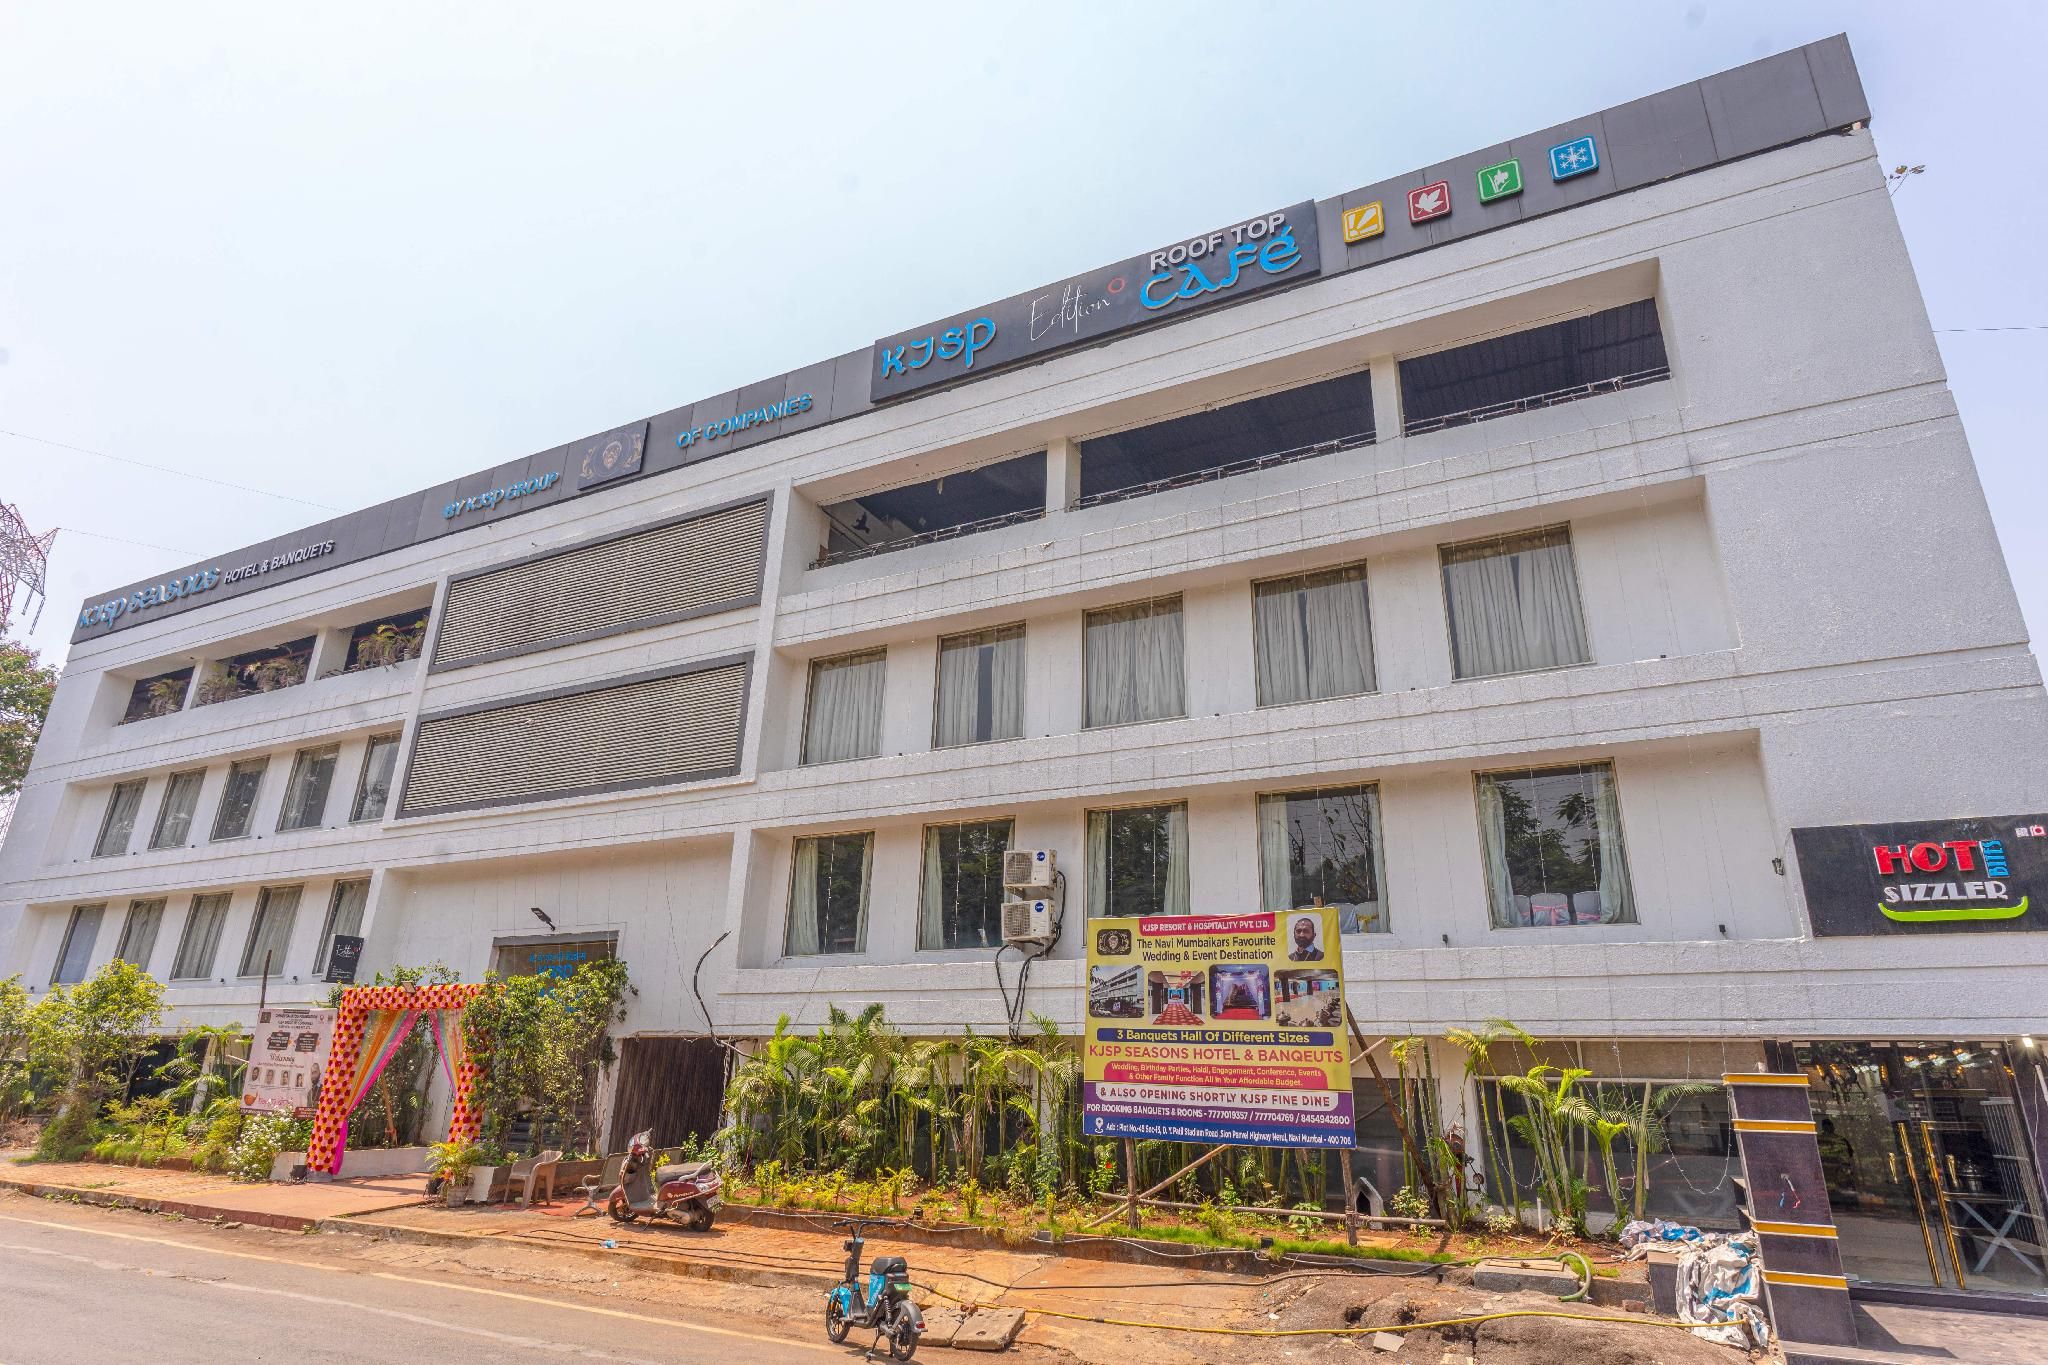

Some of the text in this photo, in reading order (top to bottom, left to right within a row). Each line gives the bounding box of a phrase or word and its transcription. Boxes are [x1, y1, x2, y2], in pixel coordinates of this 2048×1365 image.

[1150, 213, 1285, 273] ROOF TOP
[505, 471, 560, 500] GROUP
[675, 427, 702, 448] OF
[703, 392, 814, 440] COMPANIES
[224, 563, 259, 584] HOTEL
[260, 560, 269, 573] &
[270, 540, 336, 570] BANQUETS
[1873, 840, 1978, 875] HOT
[1980, 840, 2010, 877] BITES
[1883, 880, 2008, 903] SIZZLER
[1160, 923, 1186, 931] RESORT
[1194, 921, 1238, 930] HOSPITALITY
[1255, 920, 1270, 928] LTD.
[1137, 935, 1276, 948] The Navi Mumbaikars Favourite
[1142, 949, 1273, 962] Wedding & Event Destination
[1117, 1029, 1310, 1043] 3 Banquets Hall Of Different Sizes
[1089, 1045, 1344, 1063] KJSP SEASONS HOTEL & BANQEUTS
[1141, 1064, 1166, 1073] Birthday
[1298, 1069, 1321, 1077] Events
[1154, 1074, 1175, 1082] Family
[1175, 1074, 1204, 1082] Function
[1223, 1076, 1238, 1084] Your
[1238, 1077, 1274, 1085] Affordable
[1100, 1087, 1330, 1106] & ALSO OPENING SHORTLY KJSP FINE DINE
[1086, 1103, 1101, 1112] FOR
[1102, 1104, 1132, 1114] BOOKING
[1133, 1105, 1170, 1115] BANQUETS
[1171, 1108, 1176, 1116] &
[1177, 1108, 1203, 1117] ROOMS
[1300, 1114, 1350, 1125] 8454942800
[1249, 1131, 1271, 1141] Highway
